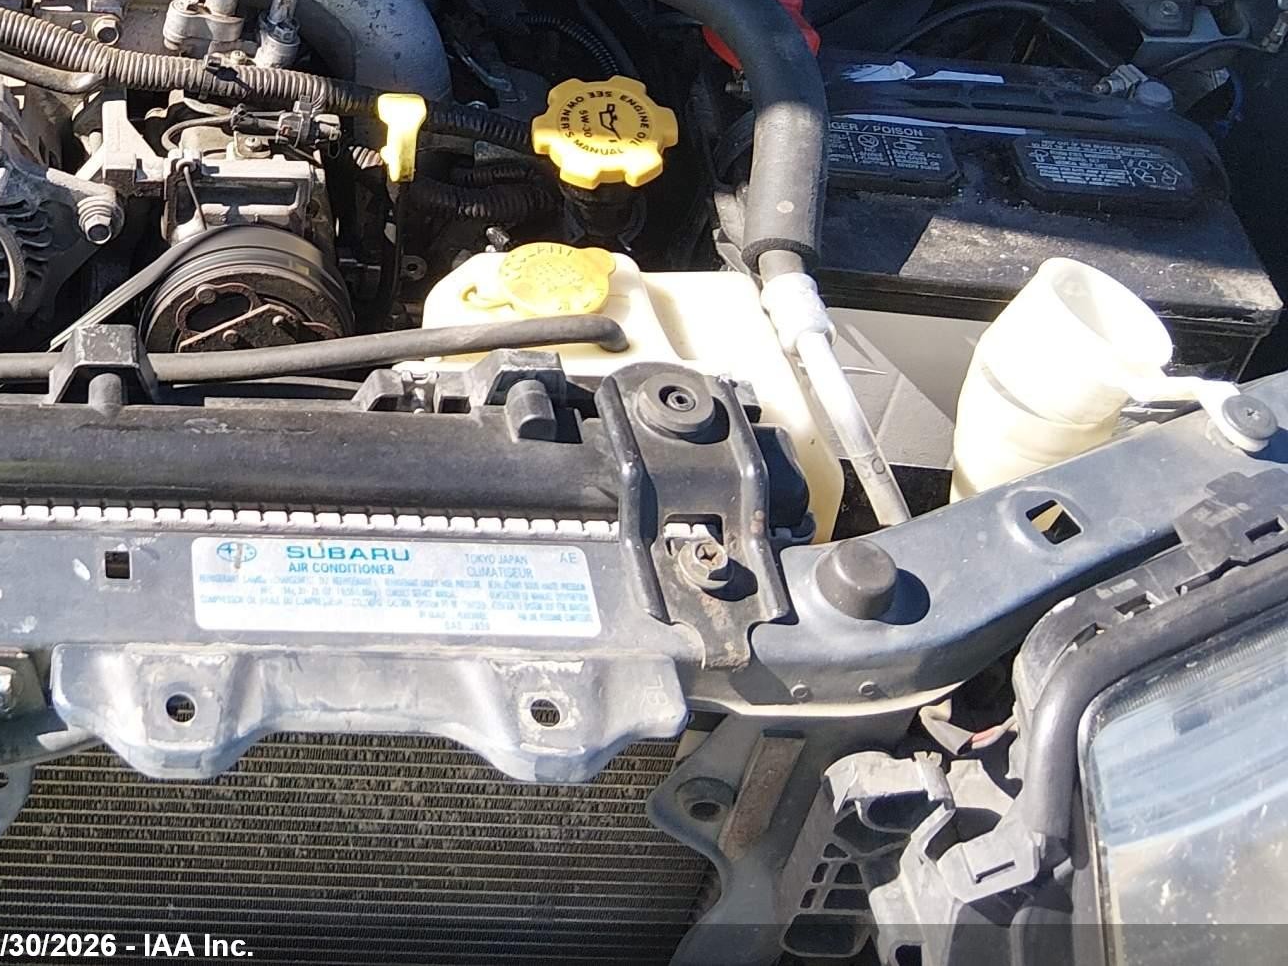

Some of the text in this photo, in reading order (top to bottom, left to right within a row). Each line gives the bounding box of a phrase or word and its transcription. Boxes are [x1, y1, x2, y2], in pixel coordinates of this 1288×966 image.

[560, 91, 624, 155] SEE OWNER'S MANUAL
[619, 94, 649, 146] ENGINE OIL
[873, 124, 924, 137] POISON
[286, 545, 410, 561] SUBARU
[464, 553, 529, 565] TOKYO JAPAN
[559, 551, 577, 564] AE
[288, 562, 395, 575] AIR CONDITIONER
